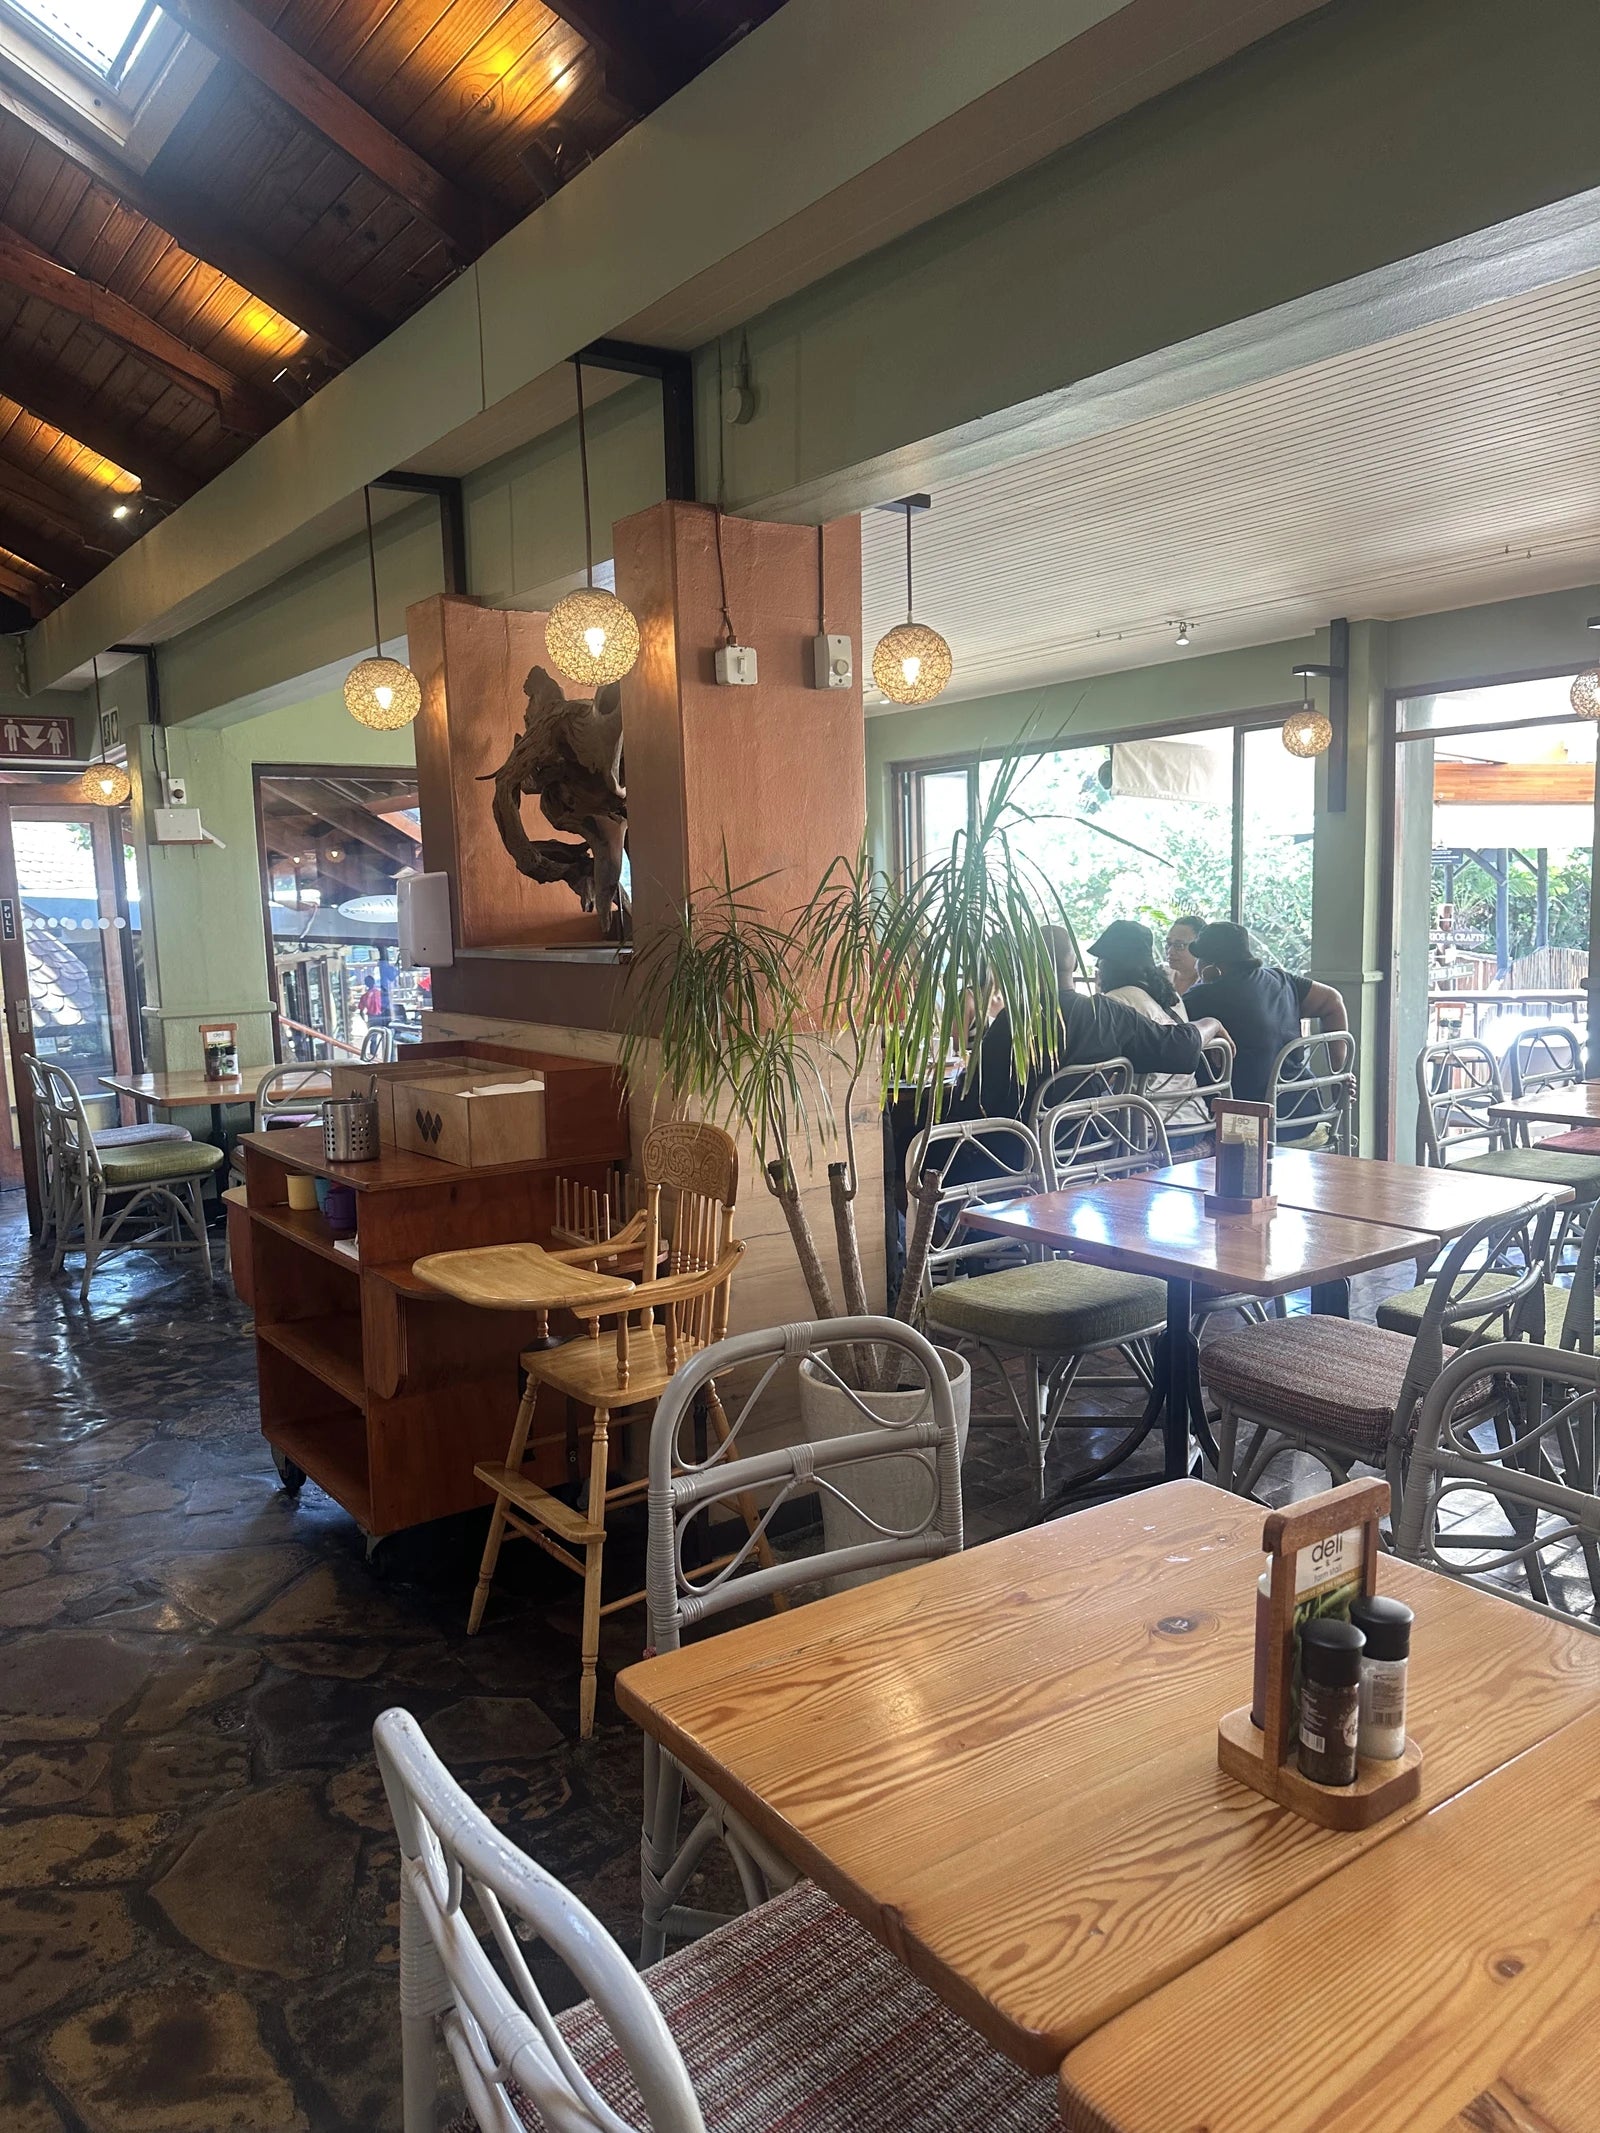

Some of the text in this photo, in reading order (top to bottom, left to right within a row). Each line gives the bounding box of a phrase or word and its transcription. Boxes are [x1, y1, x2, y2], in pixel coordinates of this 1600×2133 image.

[4, 905, 12, 933] PULL
[1454, 933, 1485, 942] CRAFTS
[1311, 1532, 1343, 1562] deli
